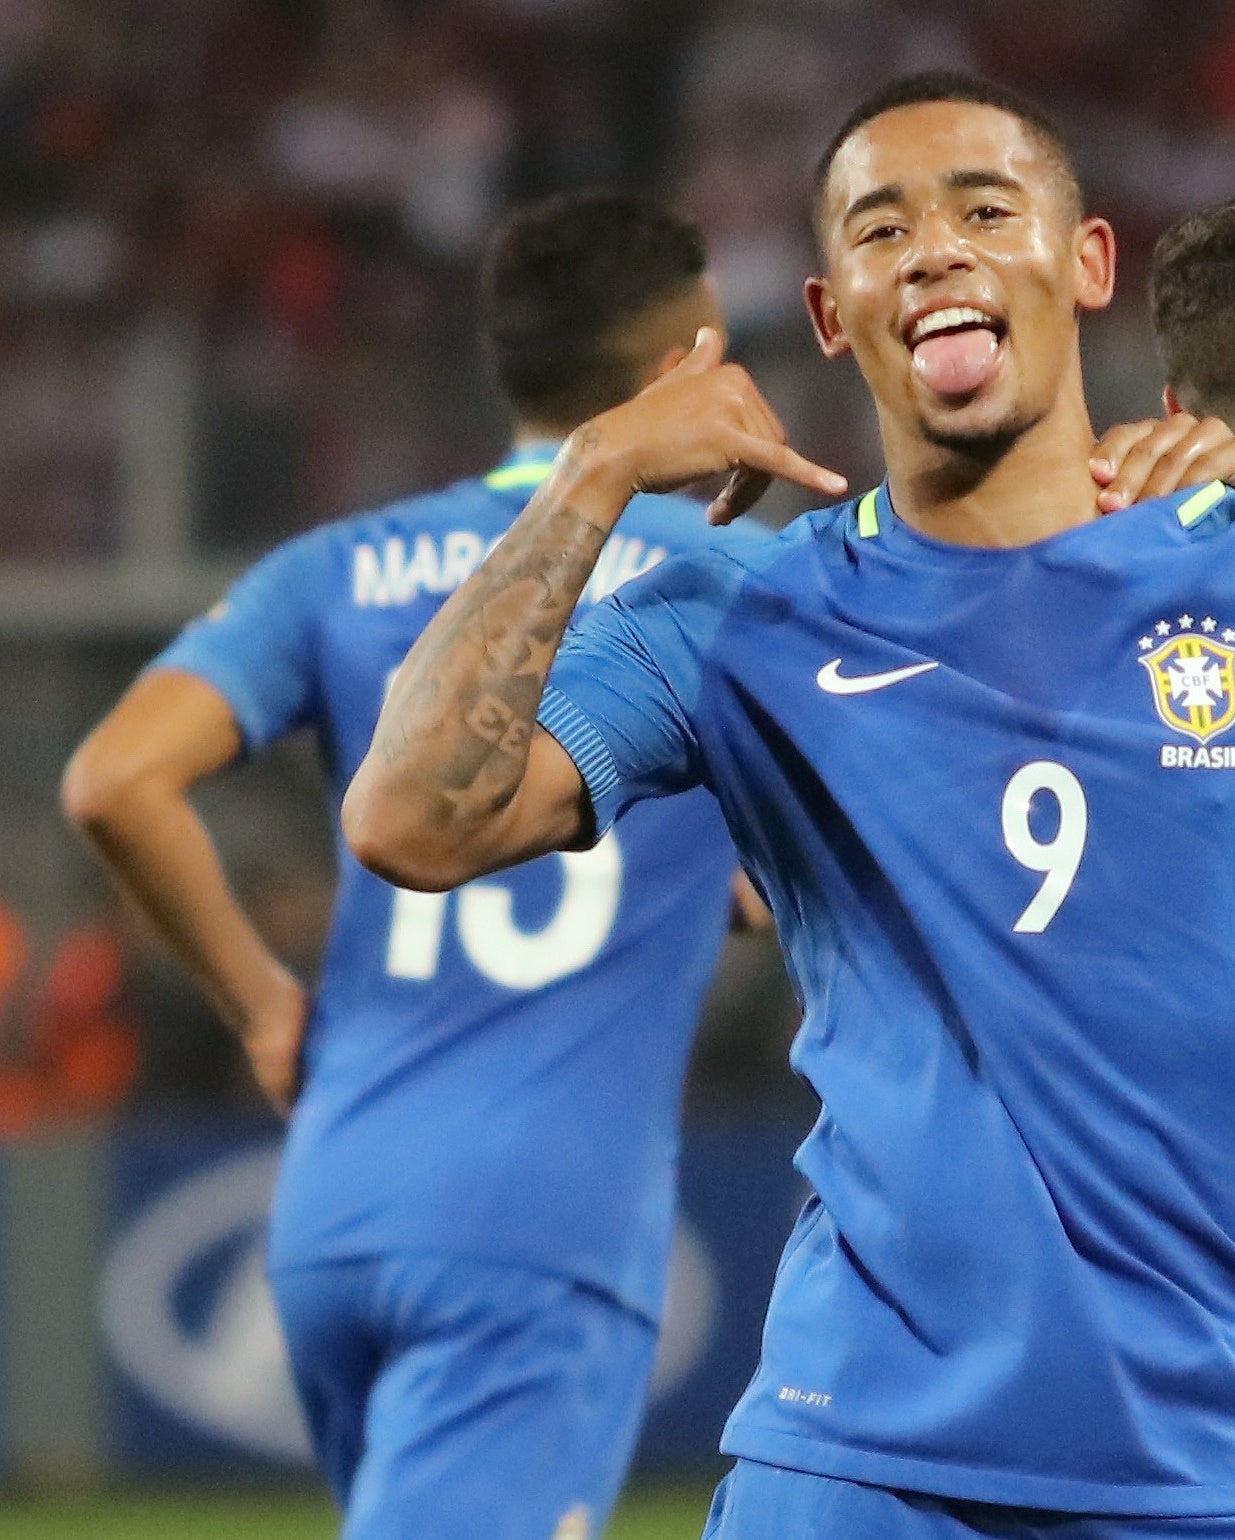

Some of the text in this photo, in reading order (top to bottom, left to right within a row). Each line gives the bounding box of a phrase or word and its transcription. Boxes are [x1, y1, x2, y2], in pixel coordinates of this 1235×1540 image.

[1180, 675, 1211, 688] CBF
[1001, 760, 1089, 935] 9
[778, 1386, 833, 1407] DRI-FIT
